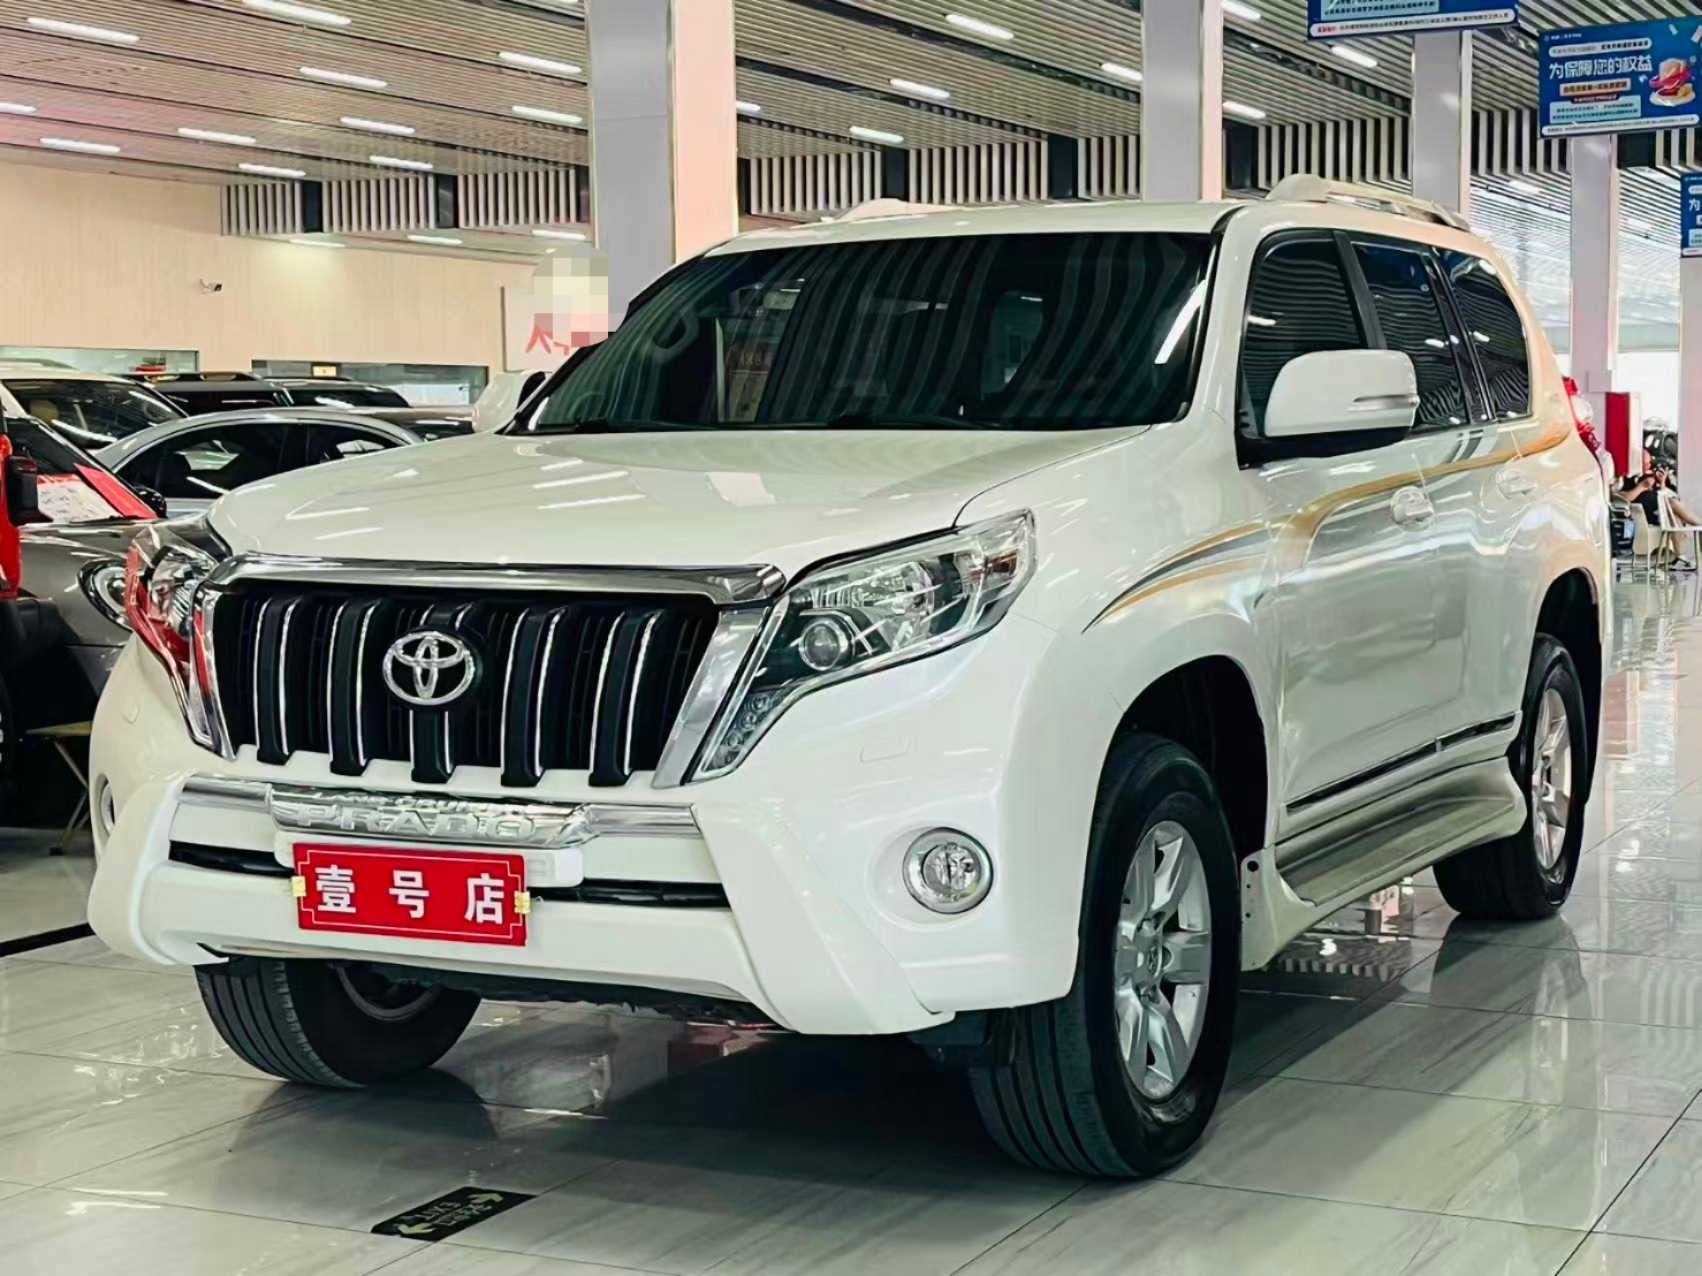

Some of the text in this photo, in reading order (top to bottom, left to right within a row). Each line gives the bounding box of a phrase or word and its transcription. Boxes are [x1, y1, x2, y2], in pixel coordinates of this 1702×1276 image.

[1549, 55, 1652, 80] 为保障您的权益
[299, 803, 536, 837] PRADO
[314, 864, 504, 924] 壹号店
